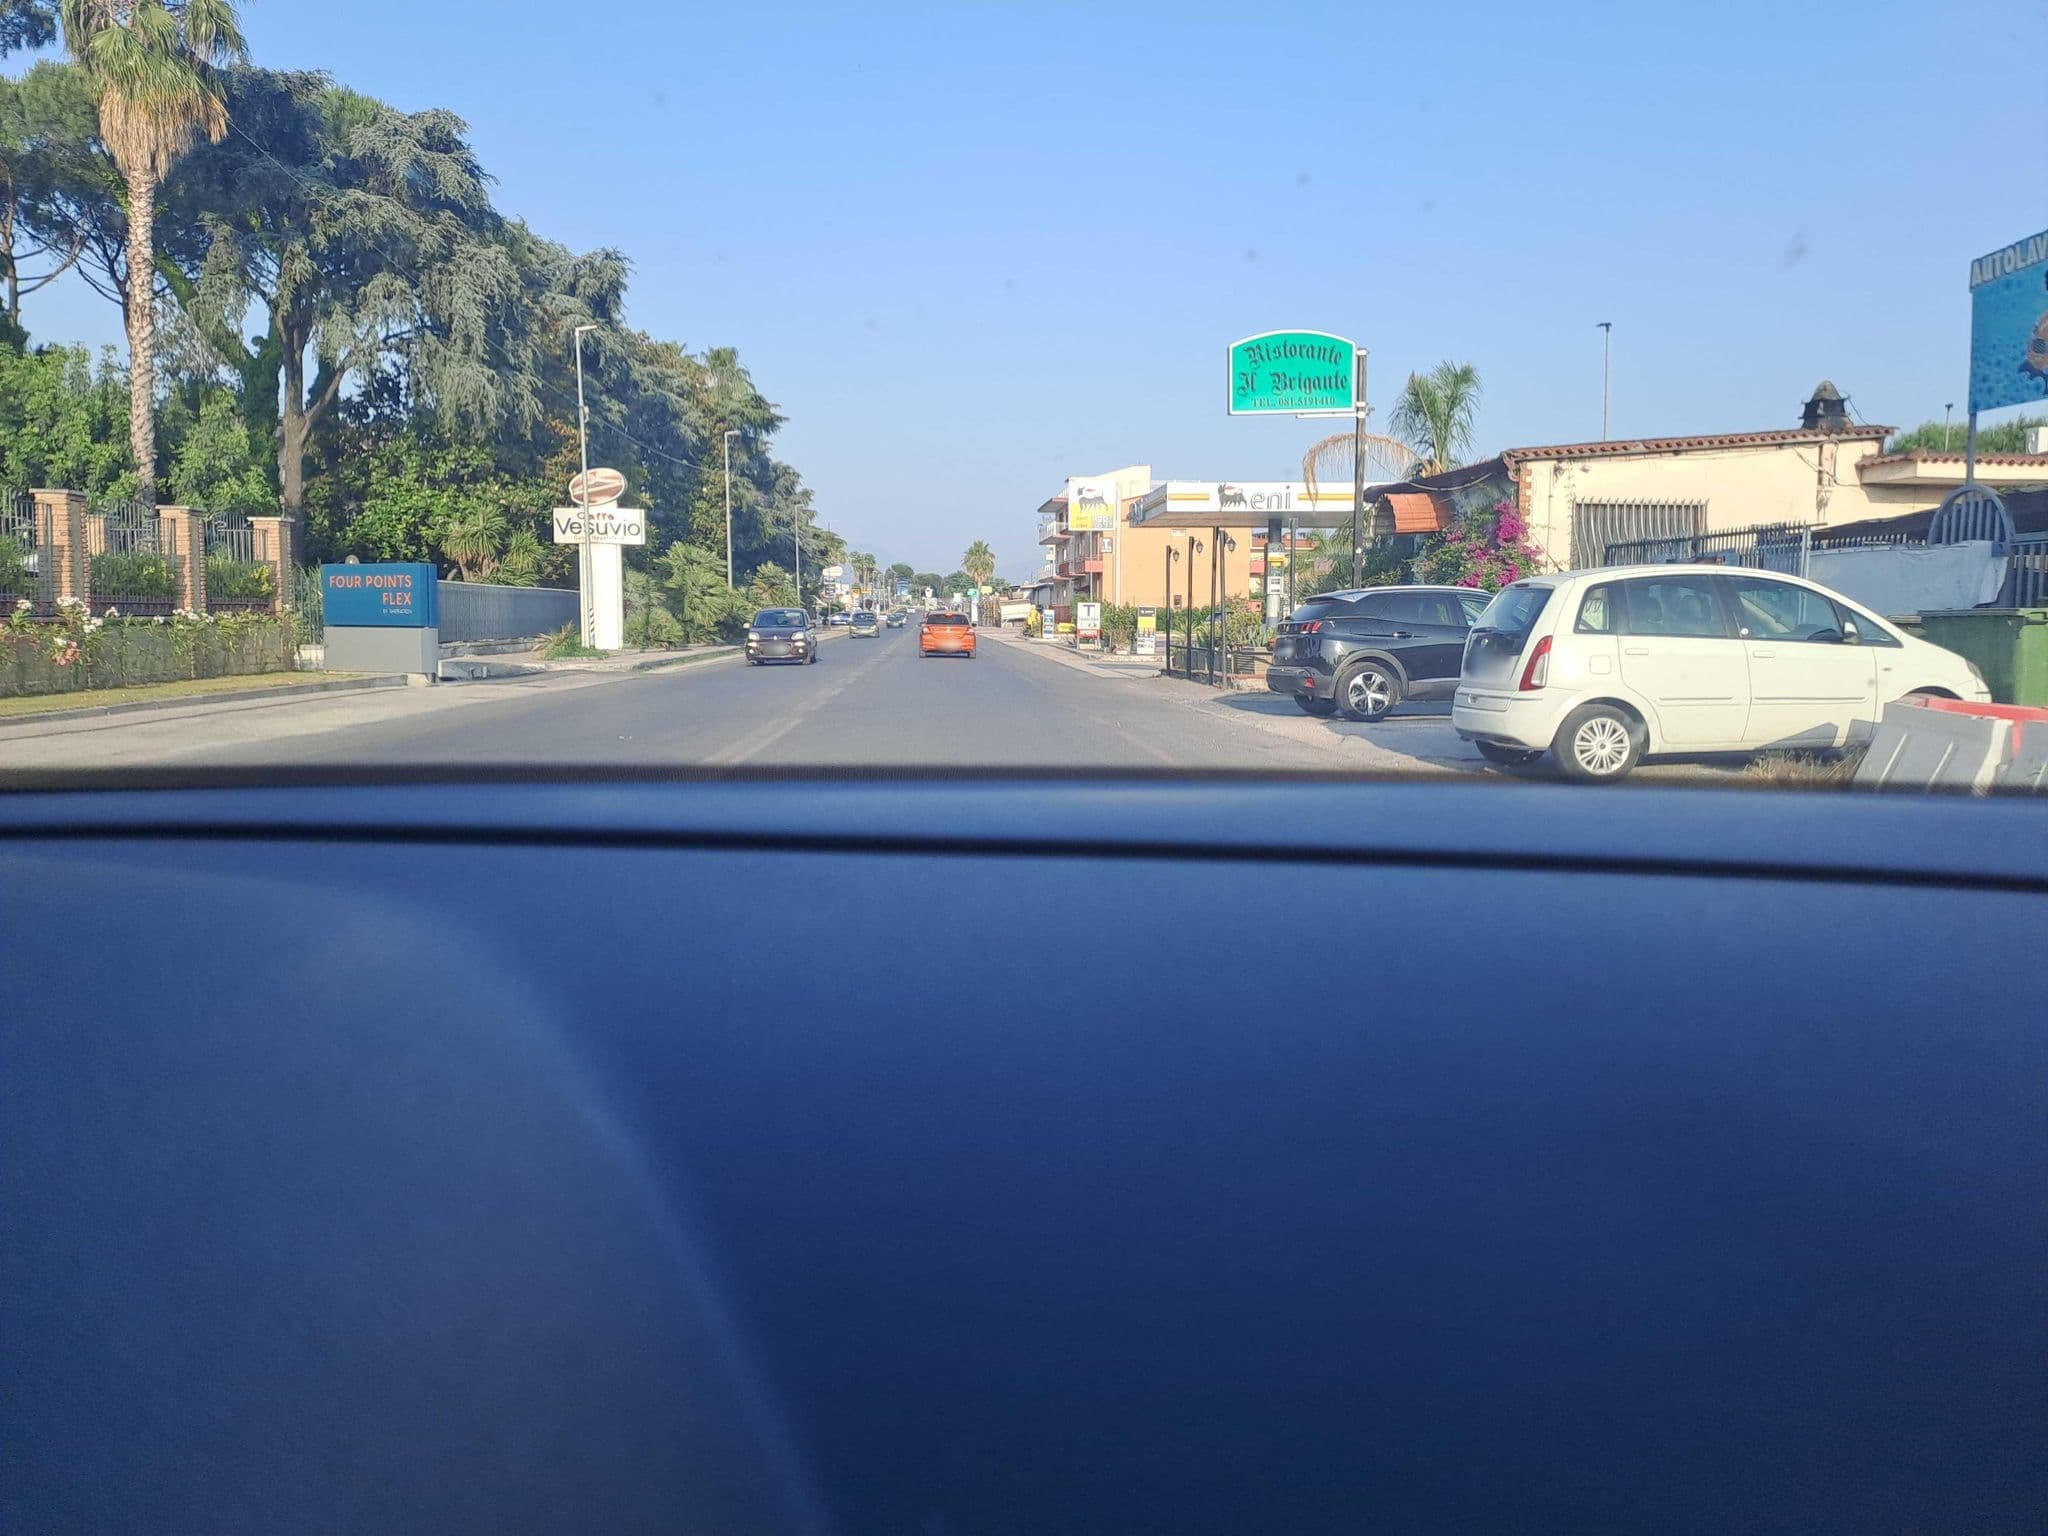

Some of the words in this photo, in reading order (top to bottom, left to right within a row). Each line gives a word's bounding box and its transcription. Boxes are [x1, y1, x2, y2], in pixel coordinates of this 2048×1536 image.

[1243, 340, 1342, 369] Ristorante
[1237, 371, 1257, 397] Il
[1270, 370, 1348, 396] Brigante
[1250, 485, 1291, 510] eni
[556, 517, 641, 536] Vesuvio
[329, 575, 362, 588] FOUR
[365, 574, 412, 588] POINTS
[382, 592, 412, 606] FLEX
[1082, 604, 1096, 617] T
